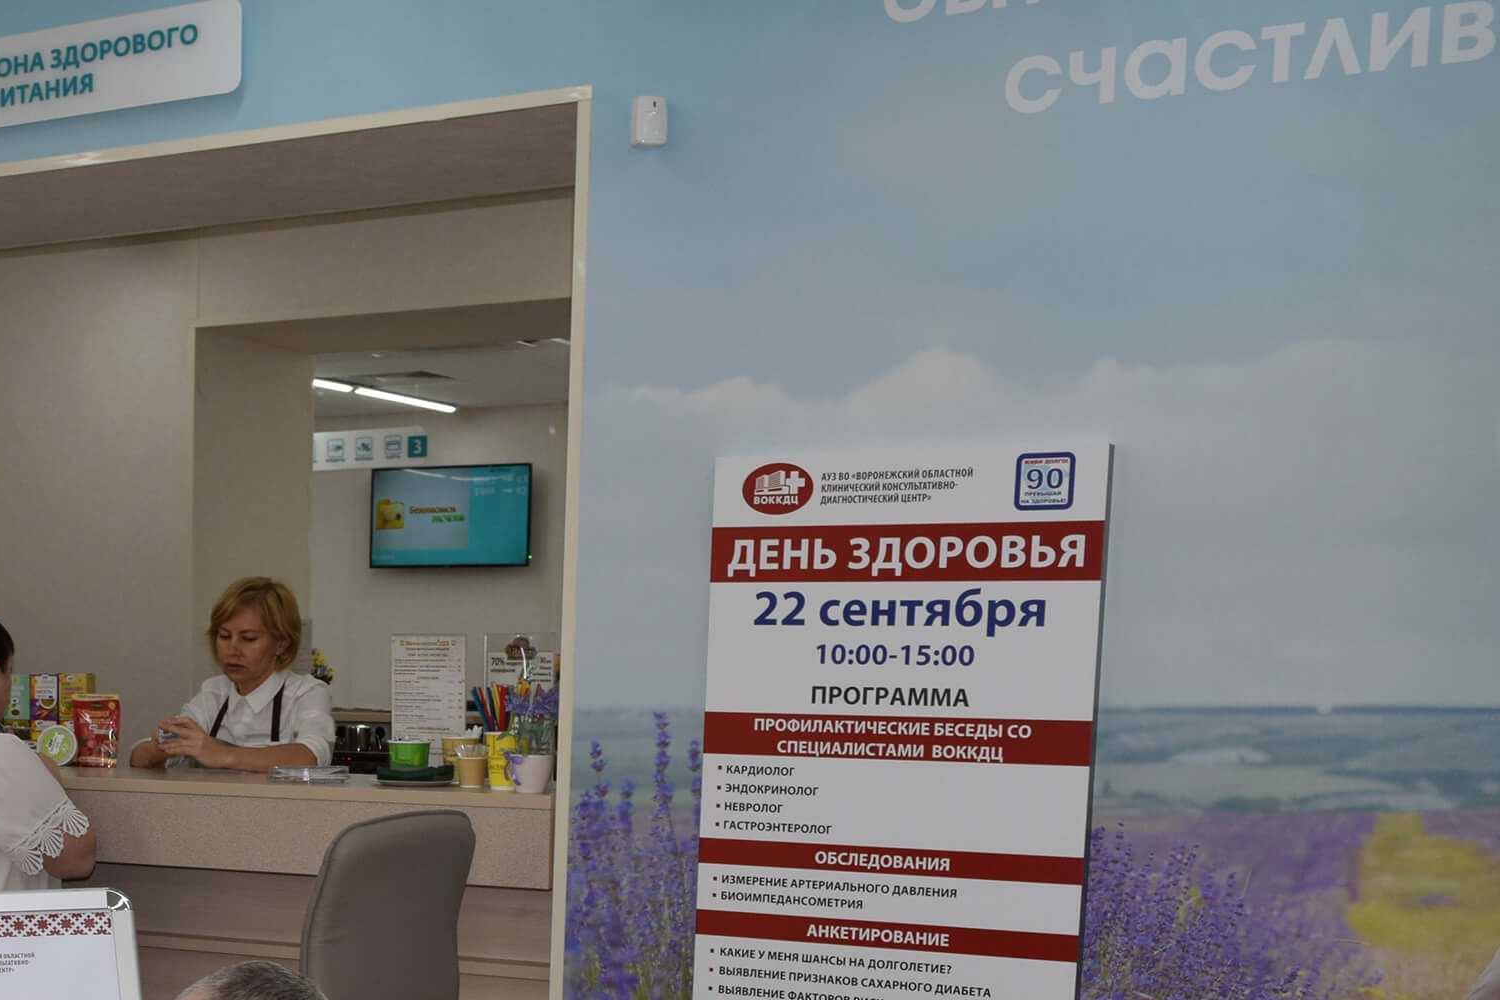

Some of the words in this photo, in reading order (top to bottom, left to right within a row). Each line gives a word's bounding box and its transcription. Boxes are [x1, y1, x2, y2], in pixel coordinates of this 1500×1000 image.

[50, 23, 199, 72] ЗДОРОВОГО
[1004, 0, 1497, 114] счастлив
[821, 472, 836, 482] АУЗ
[838, 472, 850, 481] ВО
[851, 468, 920, 481] «ВОРОНЕЖСКИЙ
[922, 466, 973, 478] ОБЛАСТНОЙ
[1026, 468, 1063, 490] 90
[821, 481, 880, 493] КЛИНИЧЕСКИЙ
[882, 480, 959, 491] КОНСУЛЬТАТИВНО-
[753, 494, 799, 506] ВОККДЦ
[820, 493, 899, 506] ДИАГНОСТИЧЕСКИЙ
[901, 493, 932, 504] ЦЕНТР»
[727, 537, 837, 577] ДЕНЬ
[848, 534, 1087, 577] ЗДОРОВЬЯ
[753, 591, 806, 626] 22
[819, 588, 1046, 637] сентября
[815, 643, 975, 667] 10:00-15:00
[810, 685, 970, 708] ПРОГРАММА
[753, 717, 930, 738] ПРОФИЛАКТИЧЕСКИЕ
[933, 723, 1003, 742] БЕСЕДЫ
[1007, 723, 1032, 739] СО
[776, 739, 925, 759] СПЕЦИАЛИСТАМИ
[931, 745, 1004, 763] ВОККДЦ
[726, 764, 796, 779] КАРДИОЛОГ
[725, 783, 819, 797] ЭНДОКРИНОЛОГ
[724, 801, 784, 814] НЕВРОЛОГ
[723, 819, 833, 835] ГАСТРОЭНТЕРОЛОГ
[814, 850, 951, 872] ОБСЛЕДОВАНИЯ
[721, 874, 788, 889] ИЗМЕРЕНИЕ
[790, 878, 891, 895] АРТЕРИАЛЬНОГО
[892, 883, 958, 899] ДАВЛЕНИЯ
[720, 890, 864, 910] БИОИМПЕДАНСОМЕТРИЯ
[806, 923, 950, 947] АНКЕТИРОВАНИЕ
[719, 947, 756, 960] КАКИЕ
[757, 949, 765, 961] У
[767, 950, 800, 963] МЕНЯ
[801, 952, 846, 966] ШАНСЫ
[848, 955, 865, 968] НА
[866, 956, 953, 976] ДОЛГОЛЕТИЕ?
[717, 984, 785, 1000] ВЫЯВЛЕНИЕ
[718, 966, 786, 982] ВЫЯВЛЕНИЕ
[787, 971, 859, 987] ПРИЗНАКОВ
[860, 976, 933, 993] САХАРНОГО
[934, 982, 991, 998] ДИАБЕТА
